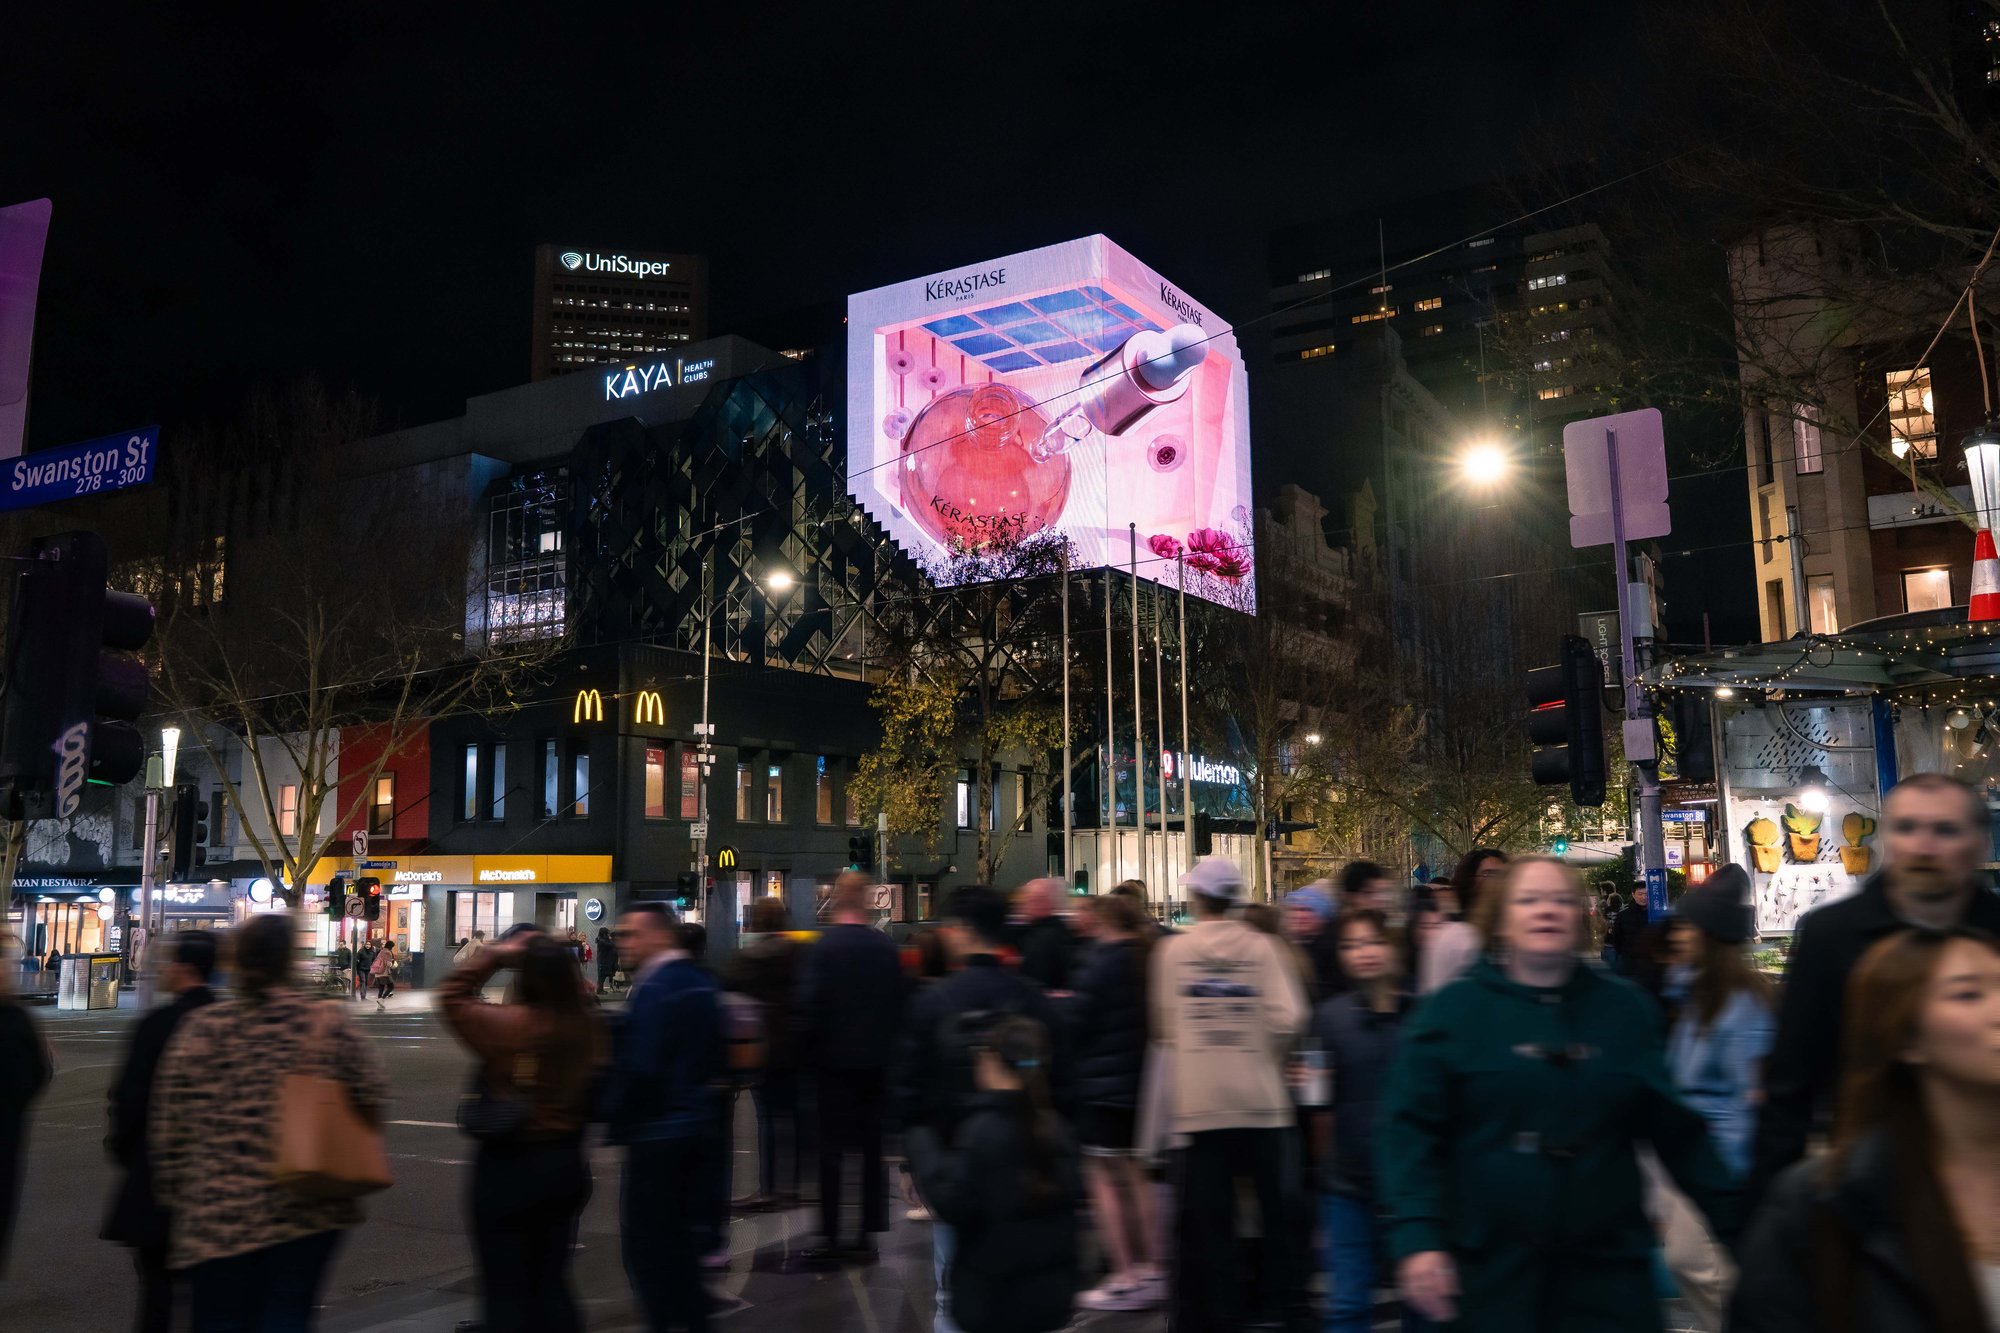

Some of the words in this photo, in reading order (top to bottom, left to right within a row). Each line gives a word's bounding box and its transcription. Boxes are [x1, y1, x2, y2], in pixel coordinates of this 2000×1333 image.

[585, 253, 670, 279] UniSuper
[926, 268, 1006, 302] KÉRASTASE
[956, 293, 975, 302] PARIS
[1161, 282, 1203, 328] KÉRASTASE
[684, 360, 713, 373] HEALTH
[684, 371, 708, 383] CLUBS
[12, 449, 119, 491] Swanston
[125, 435, 150, 468] St
[75, 474, 102, 494] 278
[117, 465, 146, 486] 300
[930, 495, 1028, 530] KÉRASTASE
[12, 879, 39, 887] AYAN
[41, 878, 97, 887] RESTAURA
[394, 871, 442, 881] McDonald's
[479, 869, 536, 881] McDonald's
